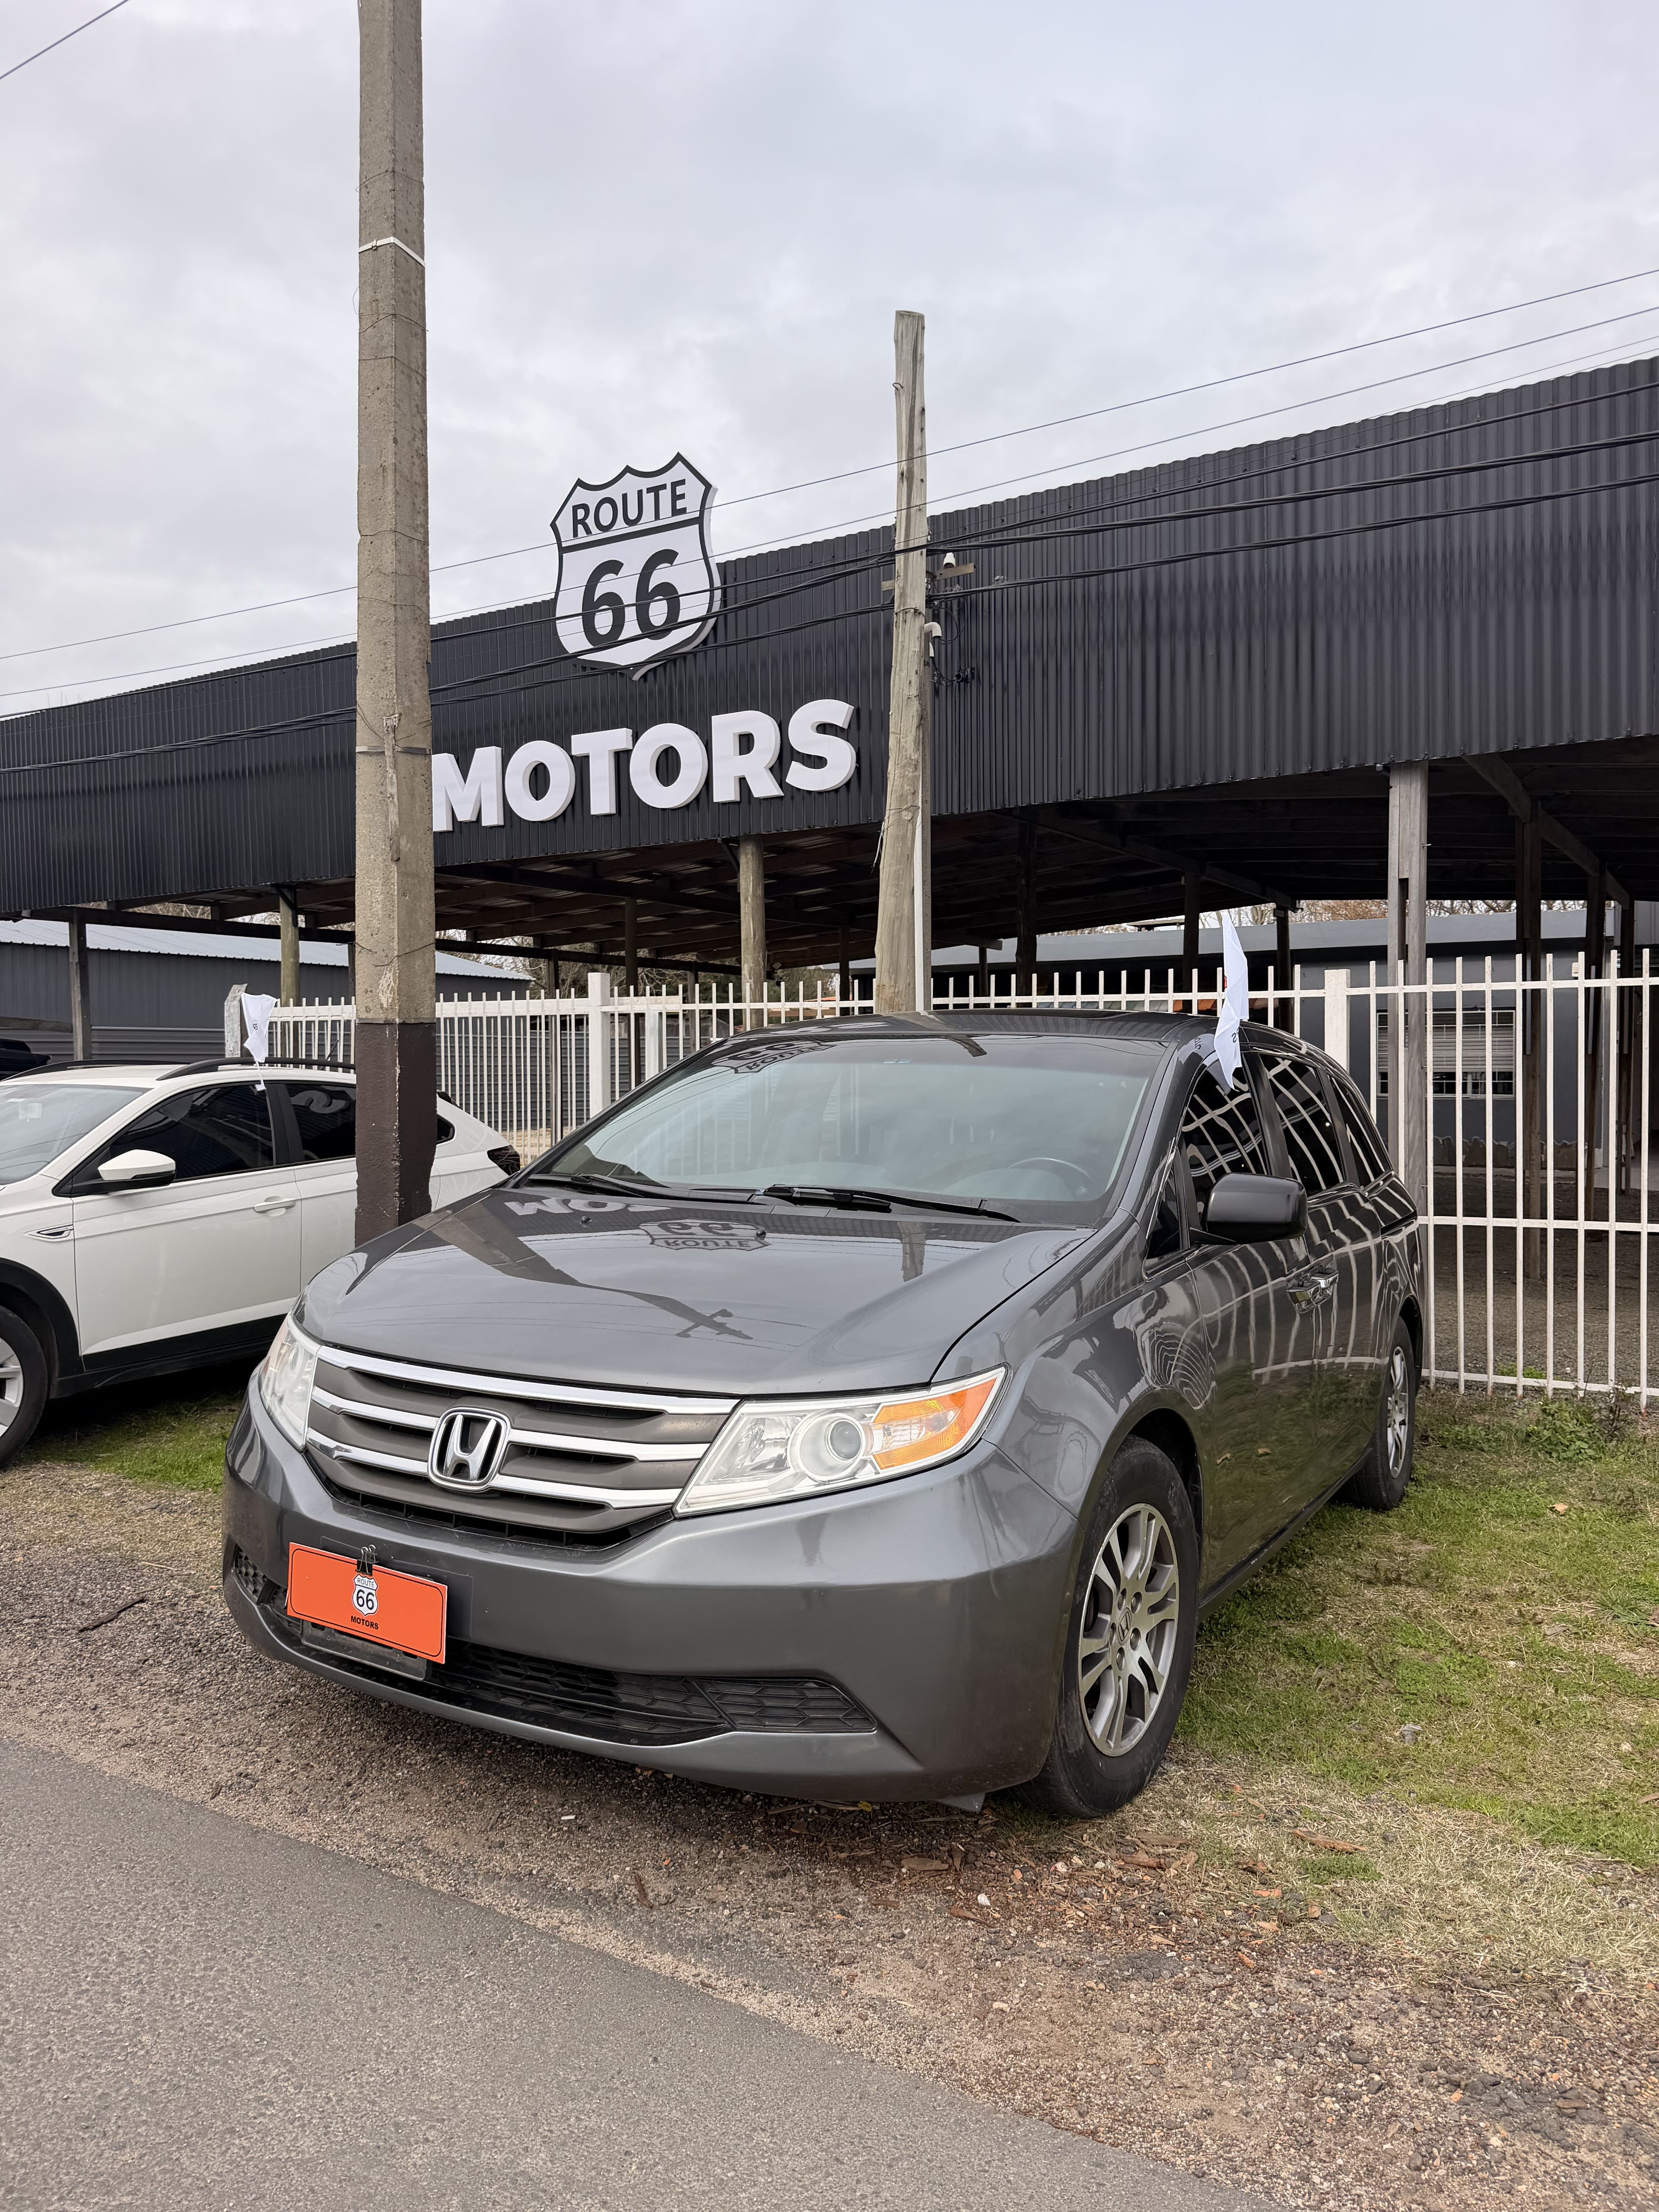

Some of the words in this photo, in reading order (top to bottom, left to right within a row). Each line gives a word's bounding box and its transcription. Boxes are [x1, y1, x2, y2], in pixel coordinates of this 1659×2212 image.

[572, 479, 687, 538] ROUTE
[582, 549, 680, 648] 66
[432, 699, 857, 832] MOTORS
[356, 1589, 375, 1610] 66
[357, 1577, 375, 1588] ROUTE
[351, 1615, 378, 1630] MOTORS
